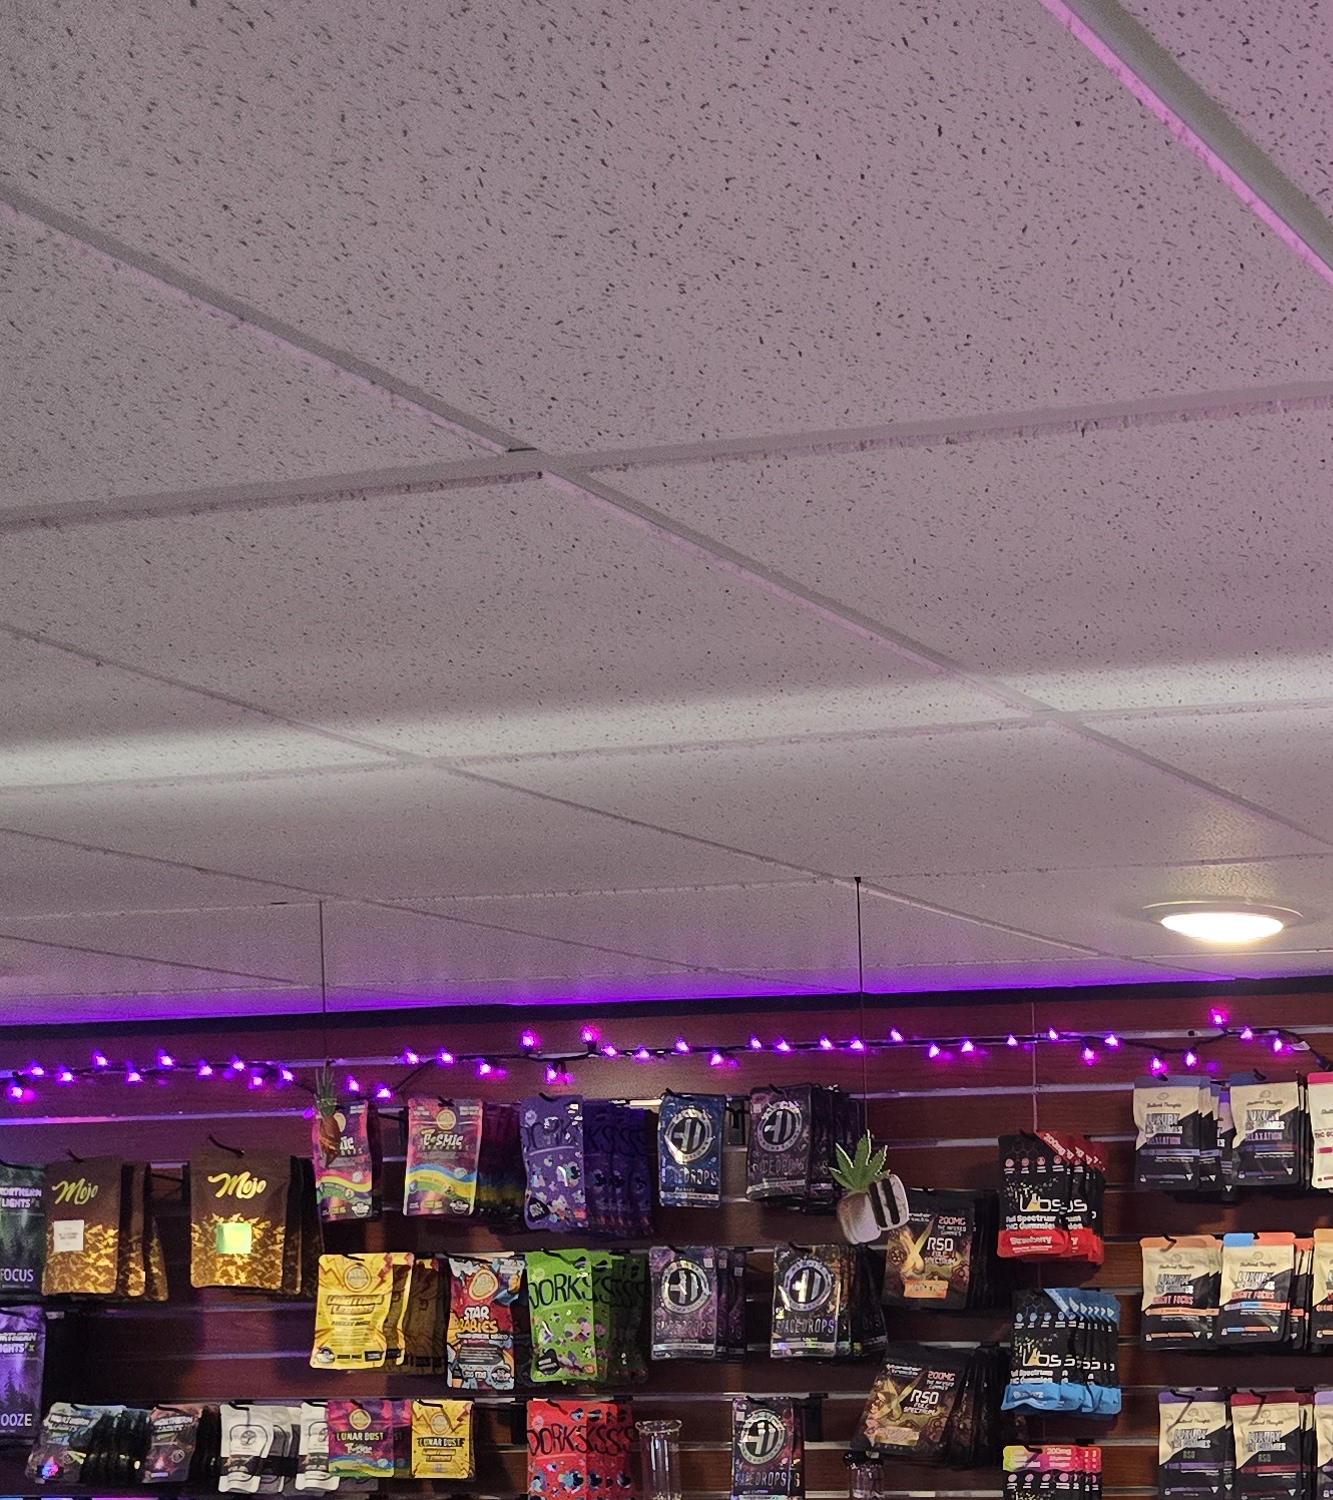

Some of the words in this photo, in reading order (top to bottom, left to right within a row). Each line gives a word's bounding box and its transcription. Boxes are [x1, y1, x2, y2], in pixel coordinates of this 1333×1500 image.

[52, 1178, 99, 1205] Mojo
[208, 1171, 266, 1199] Mojo
[939, 1216, 966, 1226] 200MG
[927, 1237, 954, 1251] RSO
[463, 1307, 490, 1320] STAR
